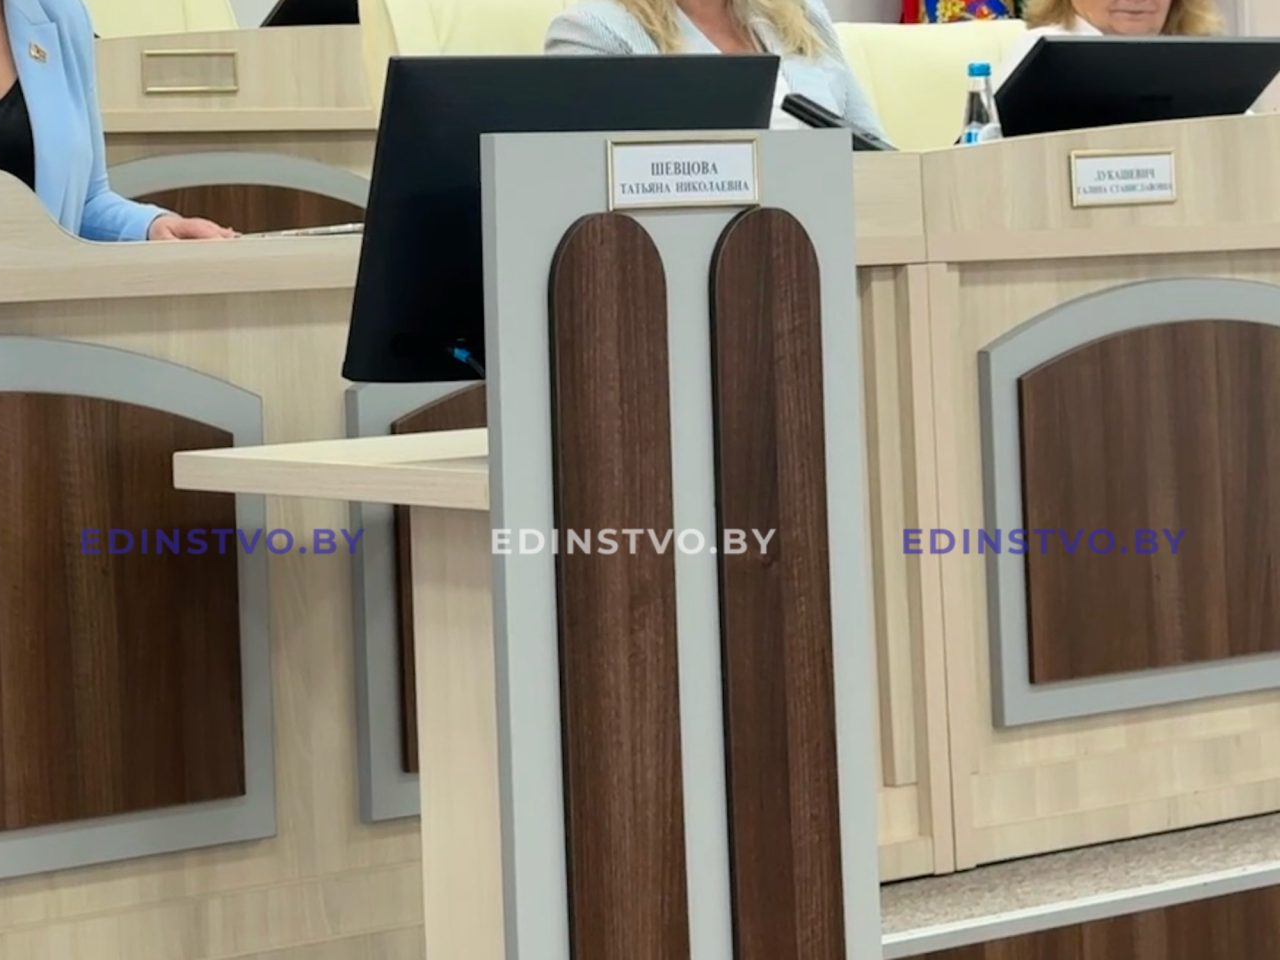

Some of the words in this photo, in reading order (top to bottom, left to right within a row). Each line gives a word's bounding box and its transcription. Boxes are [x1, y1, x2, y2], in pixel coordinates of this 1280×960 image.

[651, 161, 719, 178] ШЕВЦОВА
[1094, 167, 1155, 181] ЛУКАШЕВИЧ
[619, 181, 671, 195] ТАТЬЯНА
[675, 179, 750, 193] НИКОЛАЕВНА
